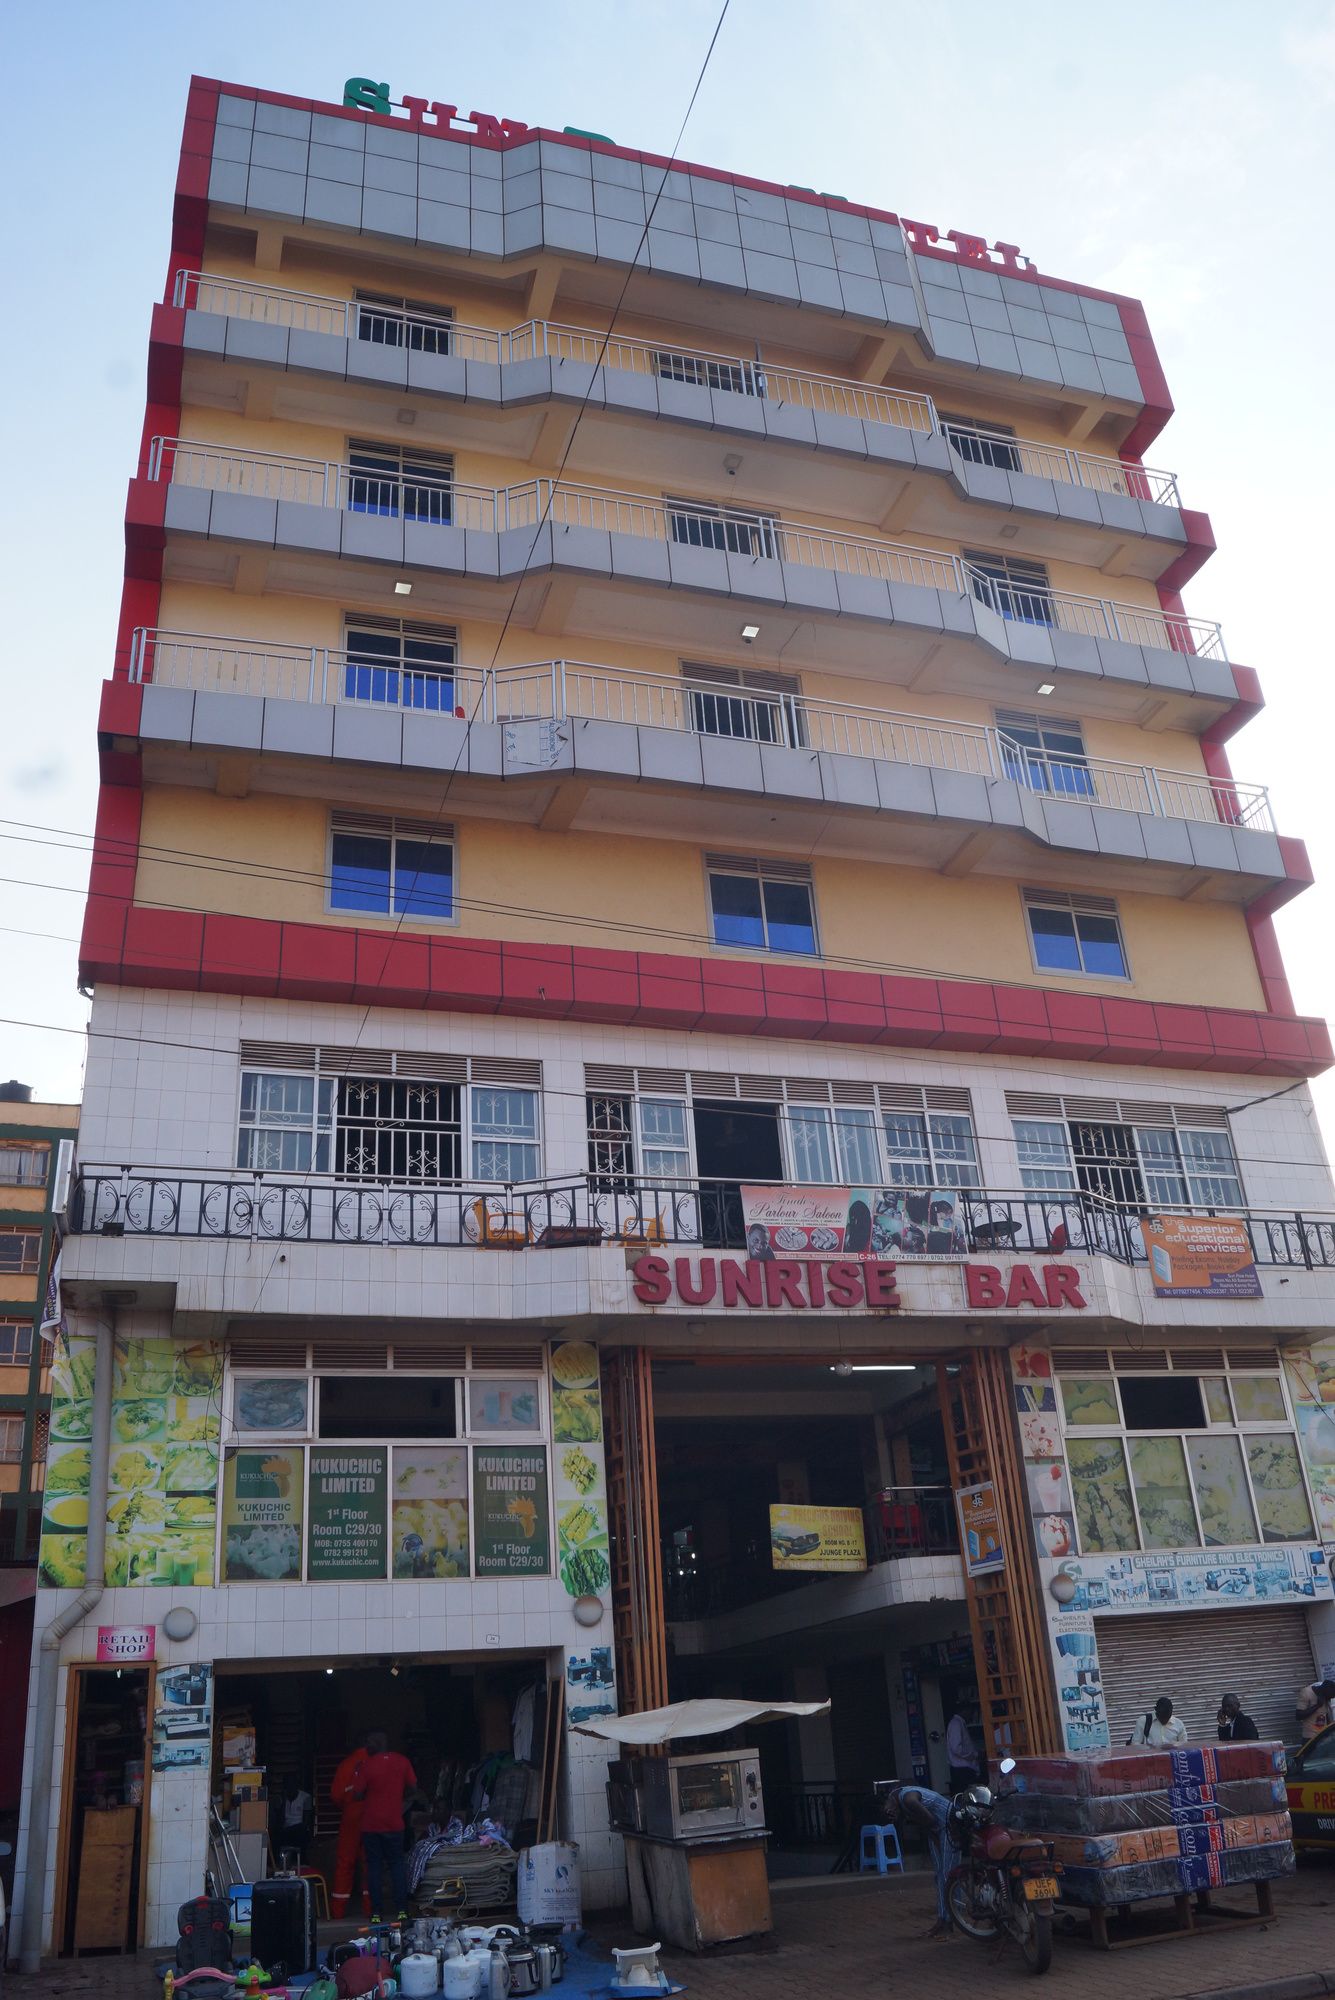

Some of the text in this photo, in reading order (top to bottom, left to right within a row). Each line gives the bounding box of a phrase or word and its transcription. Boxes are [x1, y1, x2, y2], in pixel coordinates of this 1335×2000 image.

[749, 1202, 844, 1220] Parlour Saloon
[1165, 1233, 1246, 1244] educational
[1187, 1244, 1246, 1253] services
[633, 1255, 1088, 1308] SUNRISE BAR
[311, 1458, 383, 1474] KUKUCHIC
[478, 1457, 544, 1473] KUKUCHIC
[321, 1477, 376, 1493] LIMITED
[486, 1475, 536, 1491] LIMITED
[238, 1503, 292, 1512] KUKUCHIC
[243, 1512, 285, 1521] LIMITED
[327, 1508, 368, 1520] 1st Floor
[312, 1523, 382, 1535] Room C29/30
[333, 1539, 351, 1547] 0755
[492, 1543, 531, 1554] 1st Floor
[323, 1549, 341, 1557] 0782
[1175, 1553, 1217, 1567] FURNITURE
[1218, 1552, 1234, 1564] AND
[1235, 1550, 1284, 1563] ELECTRONICS
[312, 1558, 380, 1566] www.kukuchic.com
[479, 1556, 544, 1567] Room C29/30
[99, 1635, 152, 1644] RETAIL
[107, 1645, 146, 1653] SHOP
[1034, 1879, 1052, 1889] UEF
[1033, 1888, 1055, 1898] 369U
